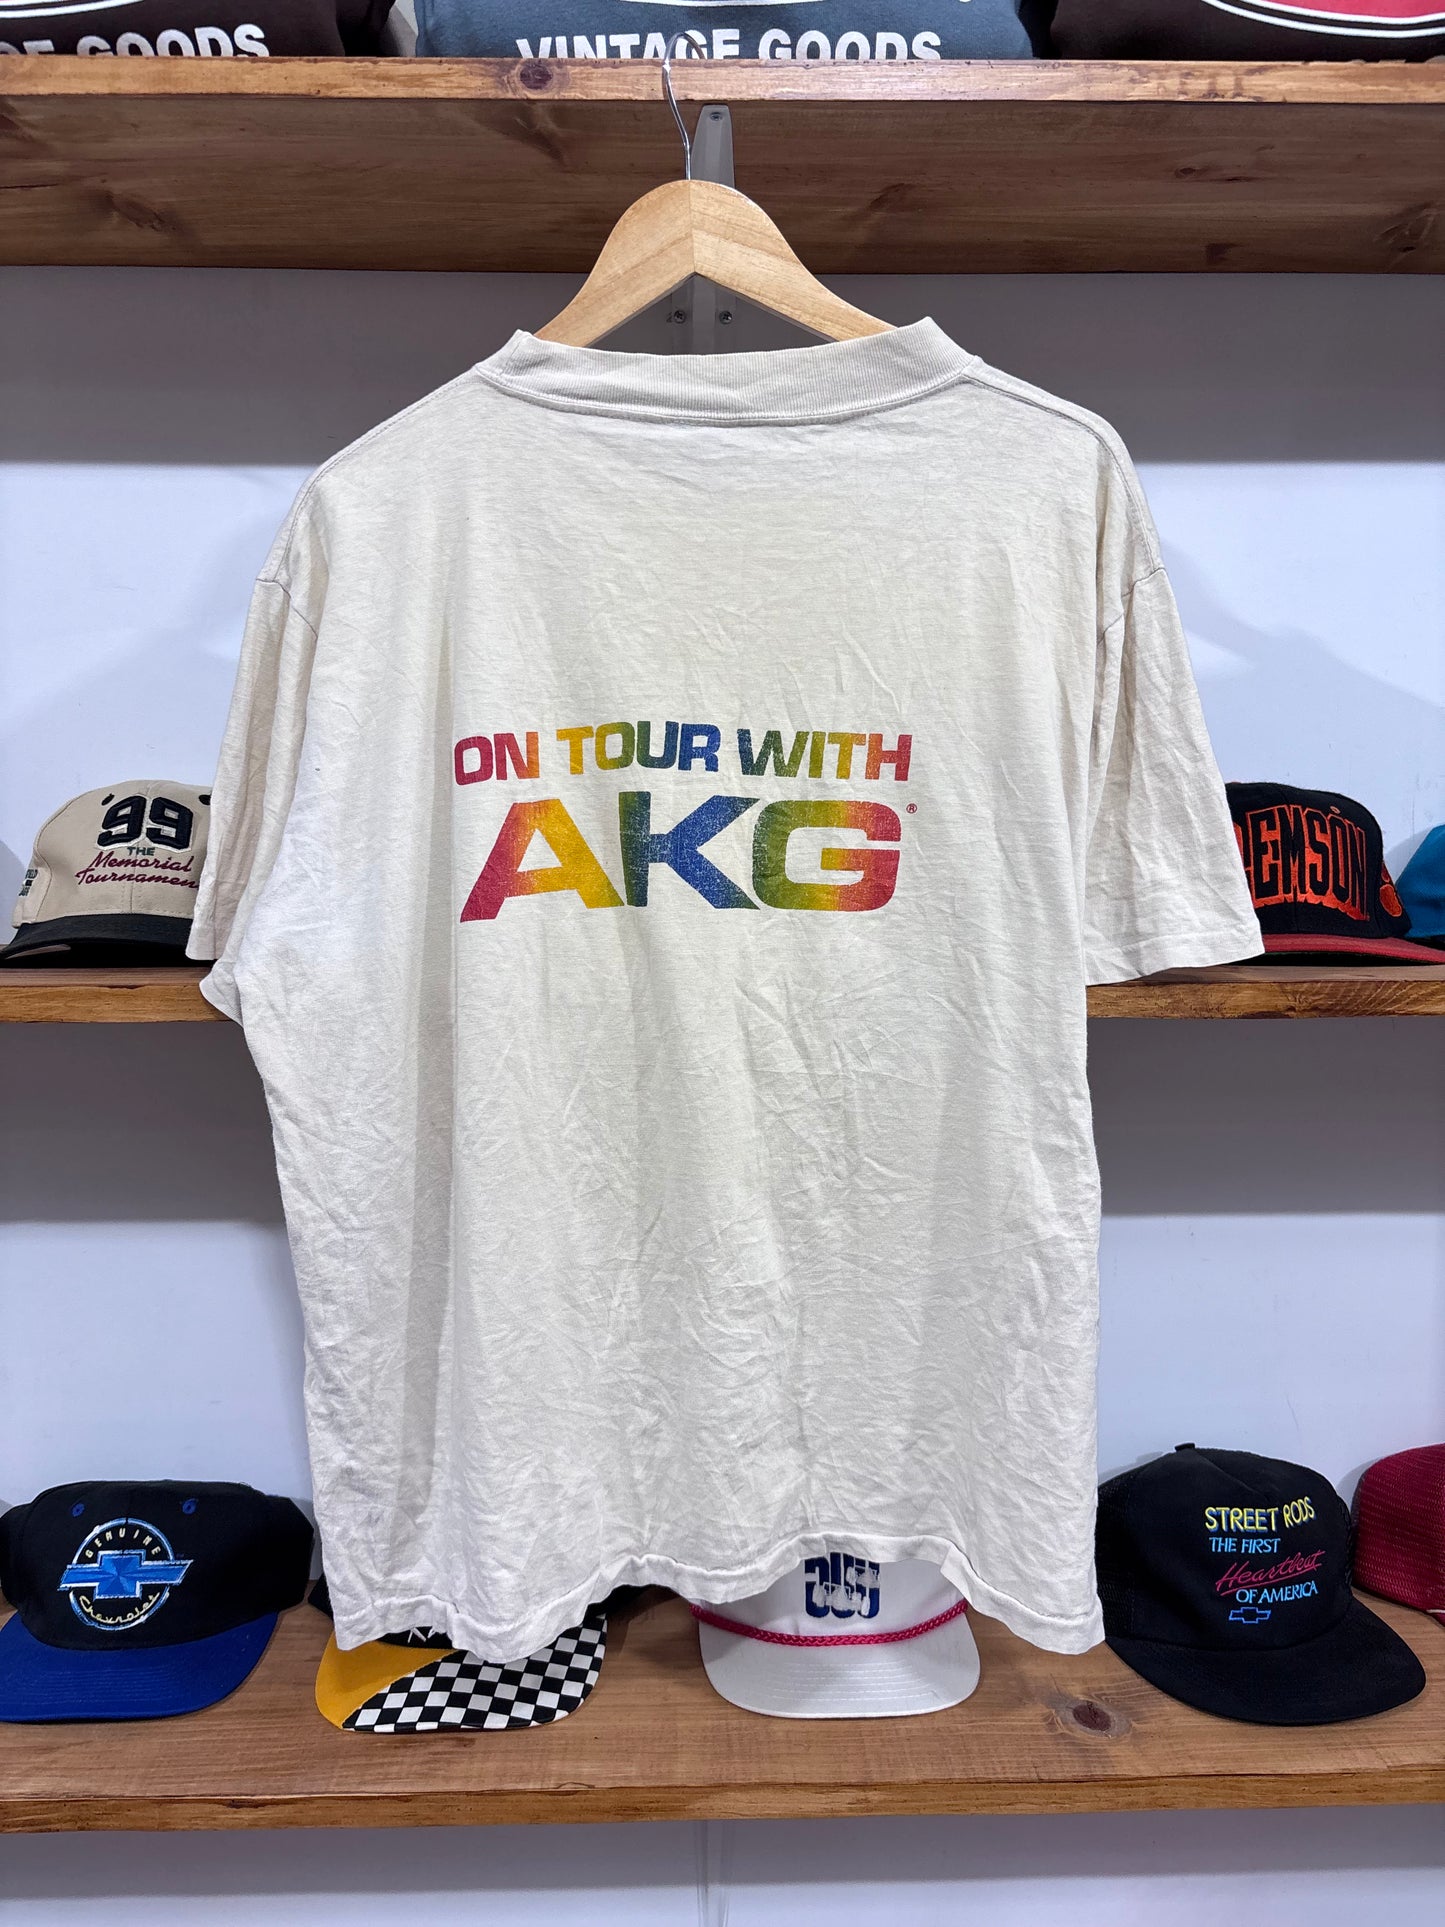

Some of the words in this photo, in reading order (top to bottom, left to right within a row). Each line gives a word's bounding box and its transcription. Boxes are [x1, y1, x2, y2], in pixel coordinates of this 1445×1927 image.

[758, 28, 942, 60] GOODS
[453, 731, 540, 786] ON
[556, 720, 722, 776] TOUR
[736, 728, 913, 782] WITH
[86, 850, 195, 873] Memorial
[126, 846, 156, 857] THE
[460, 791, 902, 923] AKG
[1240, 804, 1369, 920] EMSON
[74, 867, 200, 889] Tournamen
[1204, 1506, 1280, 1533] STREET
[1282, 1496, 1317, 1529] RODS
[84, 1527, 162, 1559] GENUINE
[1208, 1536, 1238, 1553] THE
[1240, 1537, 1281, 1554] FIRST
[1215, 1549, 1326, 1593] Heartbeat
[1235, 1588, 1258, 1604] OF
[1257, 1580, 1319, 1604] AMERICA
[79, 1592, 160, 1625] Chevrolet
